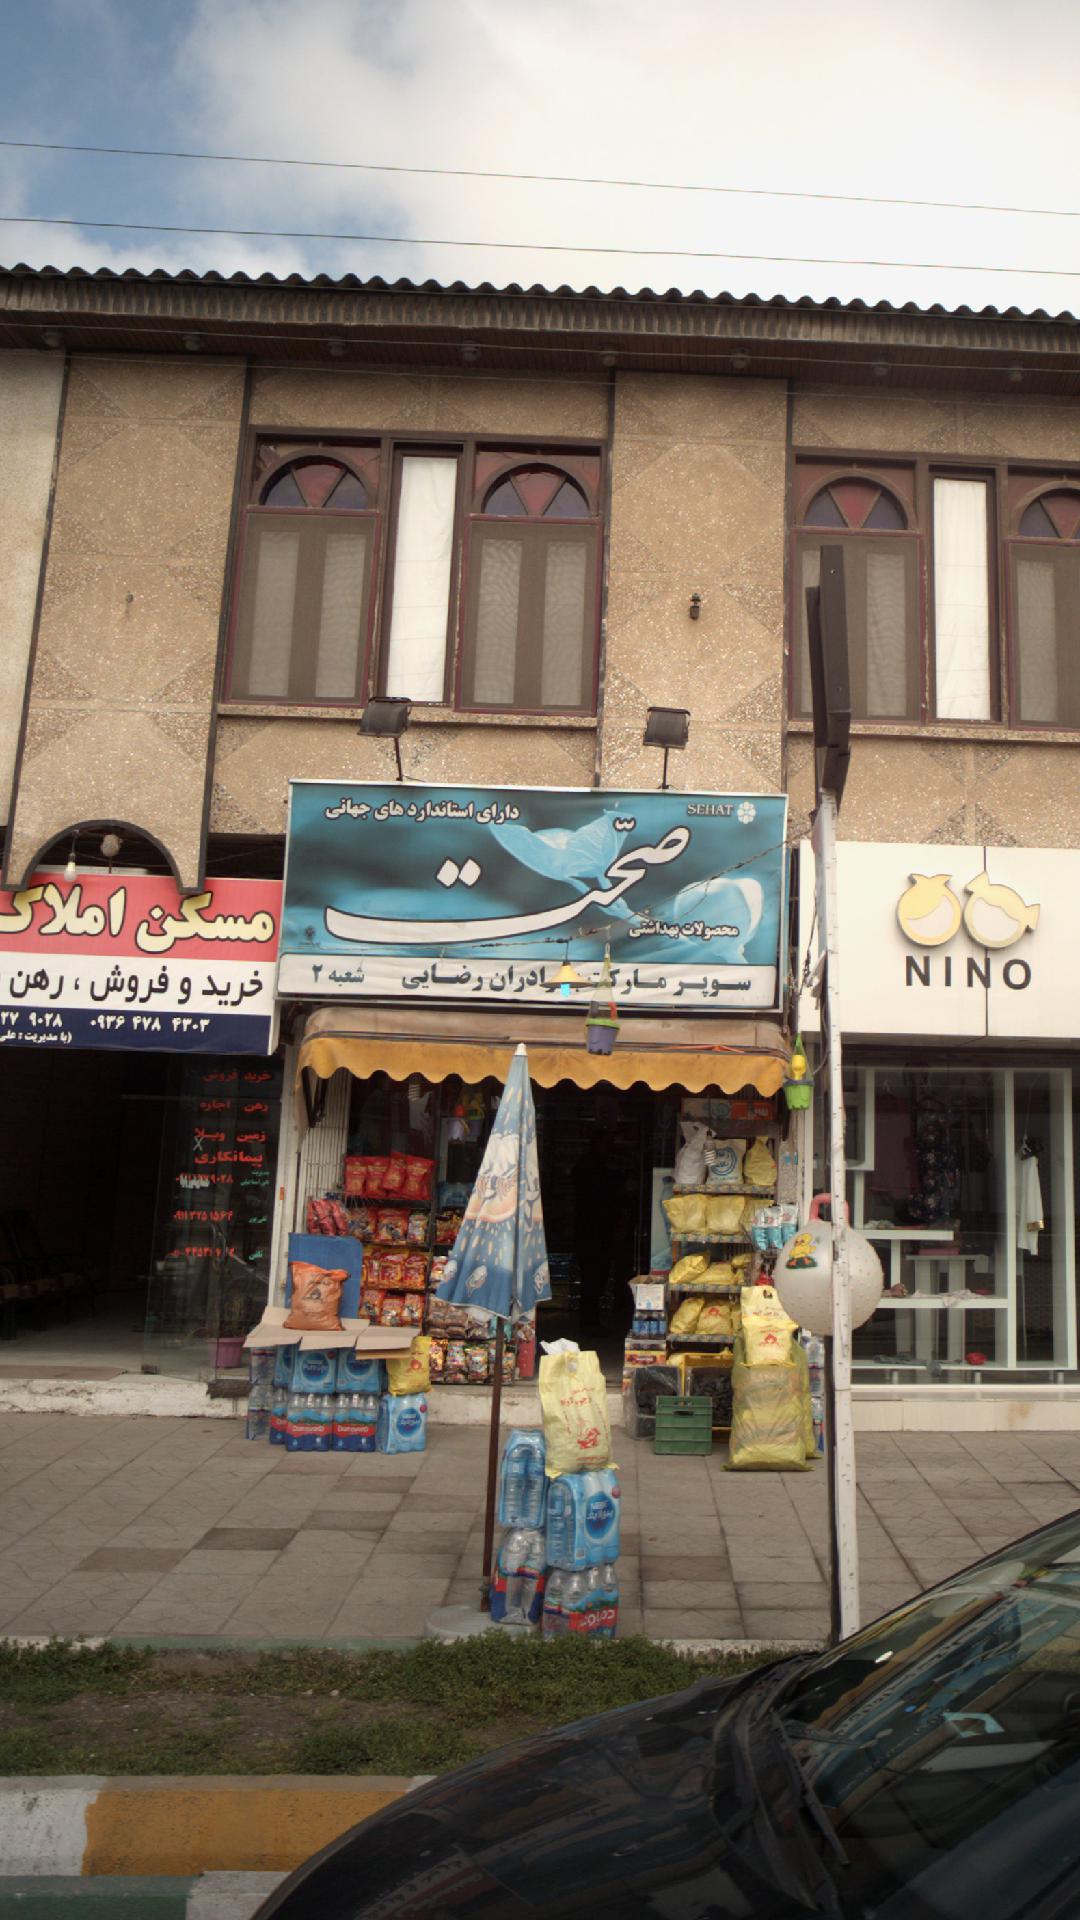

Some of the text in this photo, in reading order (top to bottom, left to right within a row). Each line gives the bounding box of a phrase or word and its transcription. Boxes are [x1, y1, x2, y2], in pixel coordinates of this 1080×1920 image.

[324, 797, 520, 824] دارای استاندارد های جهانی
[687, 803, 734, 816] SEHAT
[135, 891, 276, 954] مسکن
[628, 919, 740, 942] محصولات بهداشتی
[9, 969, 65, 999] رهن
[90, 965, 170, 1003] فروش
[312, 963, 324, 984] ۲
[328, 966, 365, 987] شعبه
[402, 962, 484, 992] رضایی
[905, 955, 1032, 990] NINO
[177, 975, 192, 1005] و
[201, 969, 263, 1006] خرید
[672, 975, 752, 998] سوپر
[29, 1011, 63, 1028] ۹۰۲۸
[90, 1014, 125, 1030] ۰۹۳۶
[132, 1016, 162, 1032] ۴۷۸
[244, 1070, 272, 1084] خرید
[199, 1100, 269, 1113] رهن اجاره
[236, 1131, 266, 1144] زمین
[194, 1151, 263, 1169] پیمانکاری
